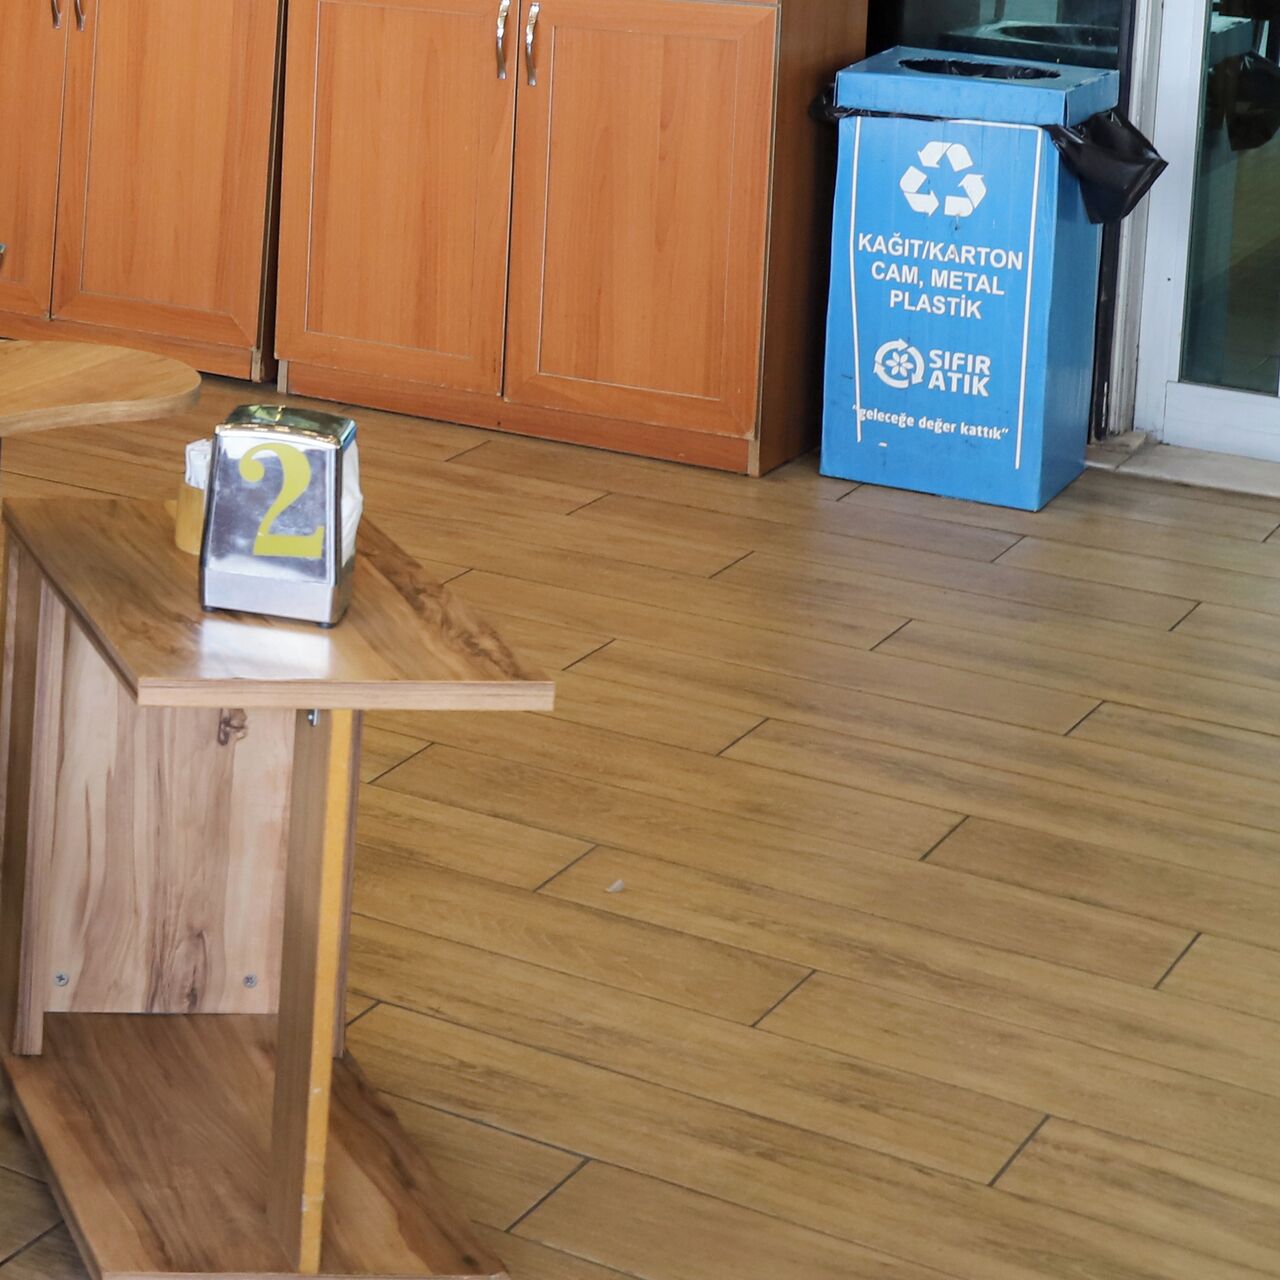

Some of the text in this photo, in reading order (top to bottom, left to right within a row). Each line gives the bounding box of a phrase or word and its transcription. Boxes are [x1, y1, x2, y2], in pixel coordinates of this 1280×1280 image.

[858, 232, 1023, 270] KAĞIT/KARTON
[871, 261, 1005, 296] CAM, METAL
[890, 289, 982, 320] PLASTİK
[928, 349, 992, 375] SIFIR
[927, 370, 991, 397] ATIK
[918, 416, 957, 434] değer
[239, 442, 326, 560] 2
